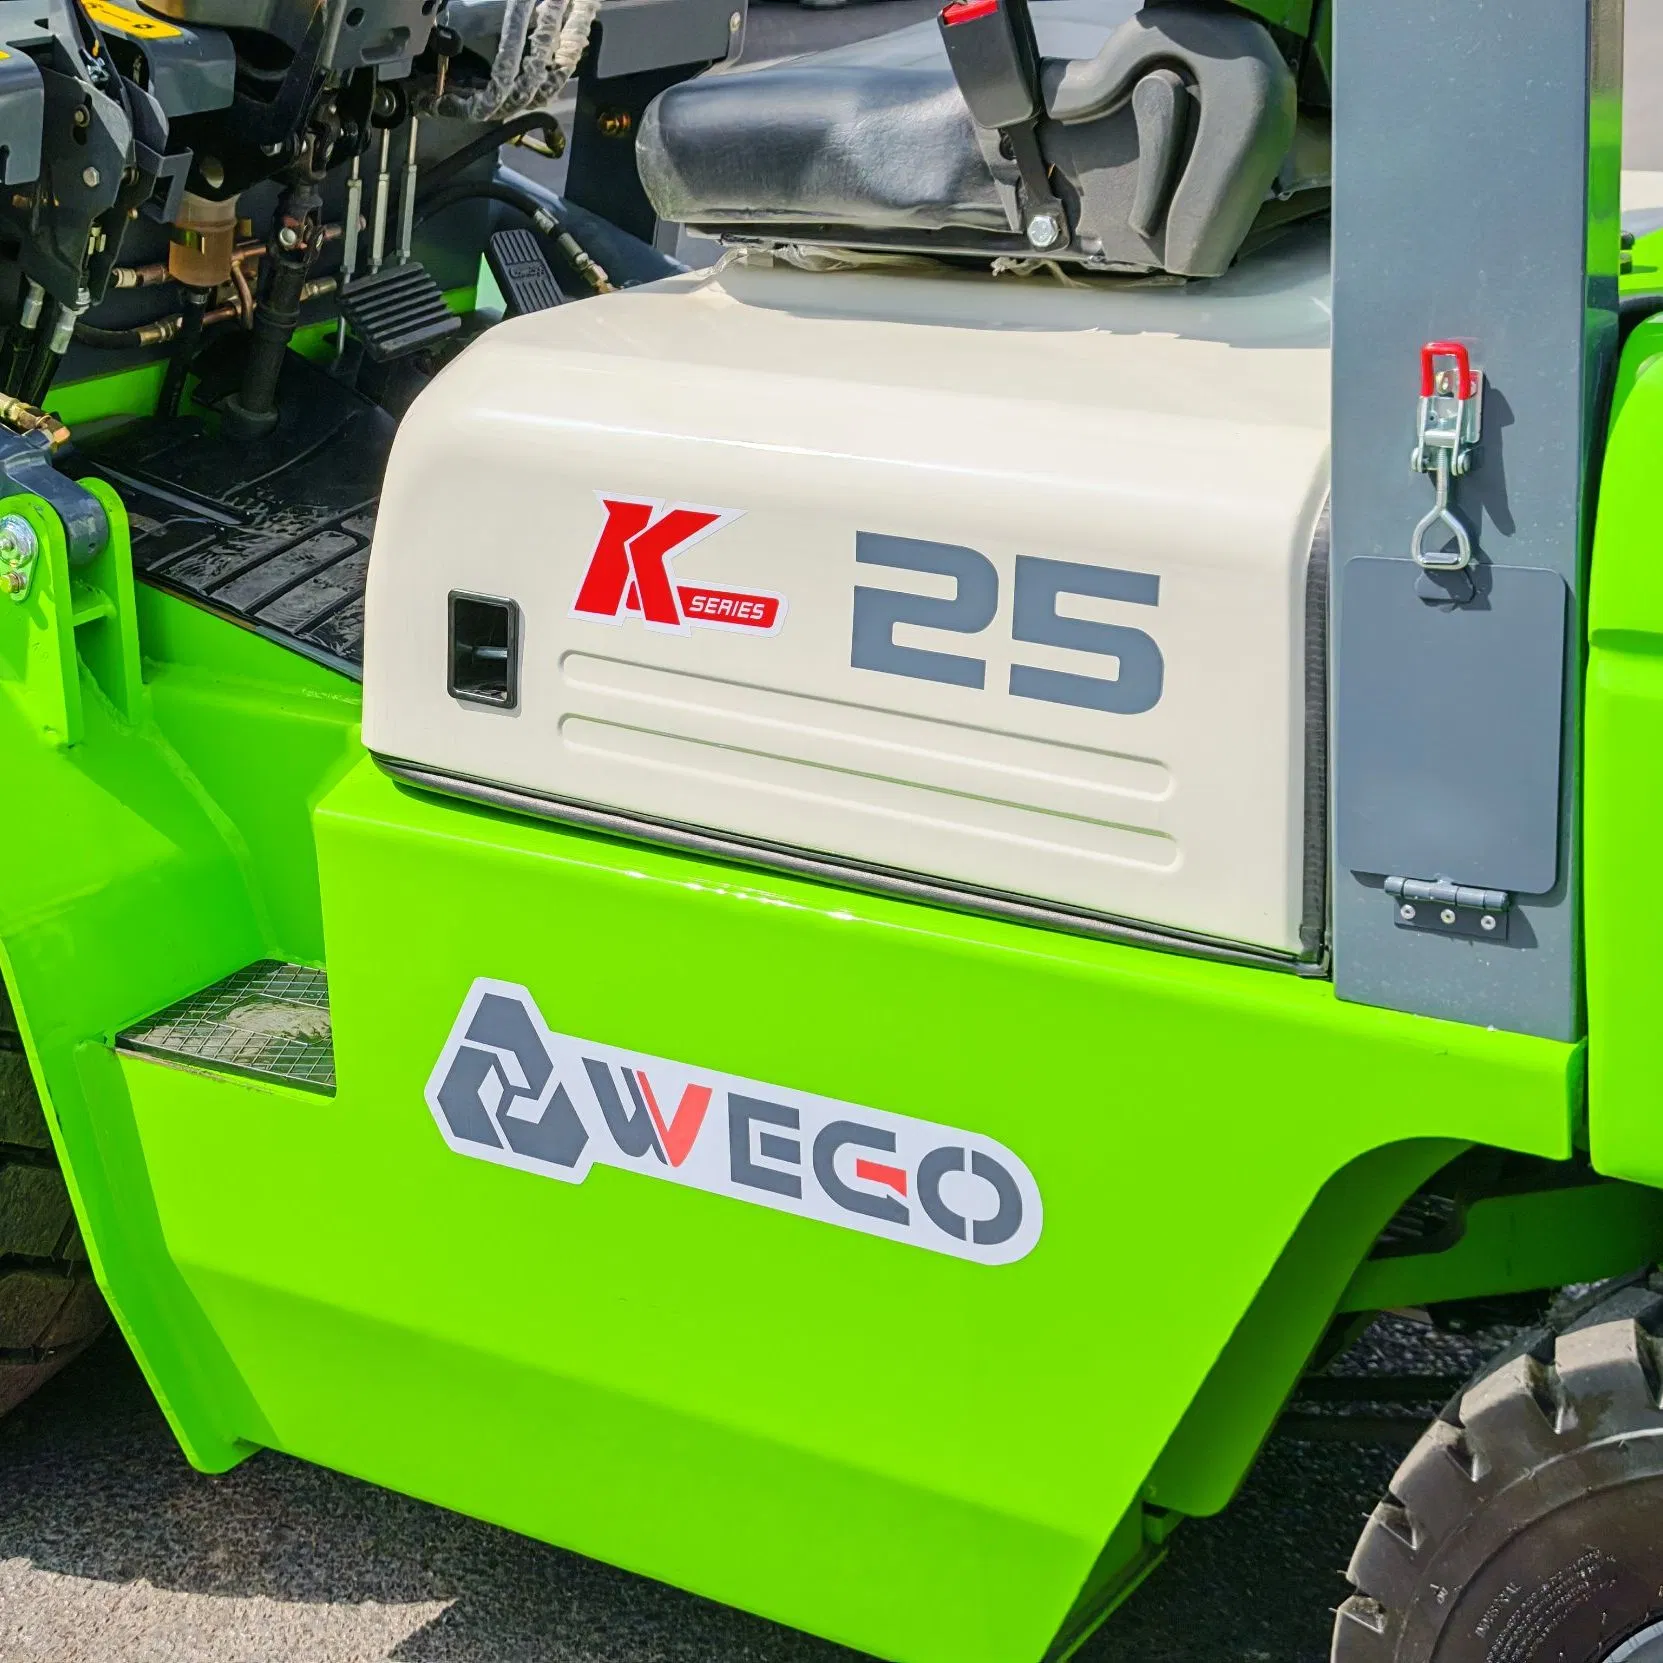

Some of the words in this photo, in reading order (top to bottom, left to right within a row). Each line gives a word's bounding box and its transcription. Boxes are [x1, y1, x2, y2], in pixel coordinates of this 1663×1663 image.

[574, 499, 722, 626] K
[688, 595, 765, 620] SERIES
[850, 529, 1165, 716] 25
[581, 1056, 1023, 1246] WEGO
